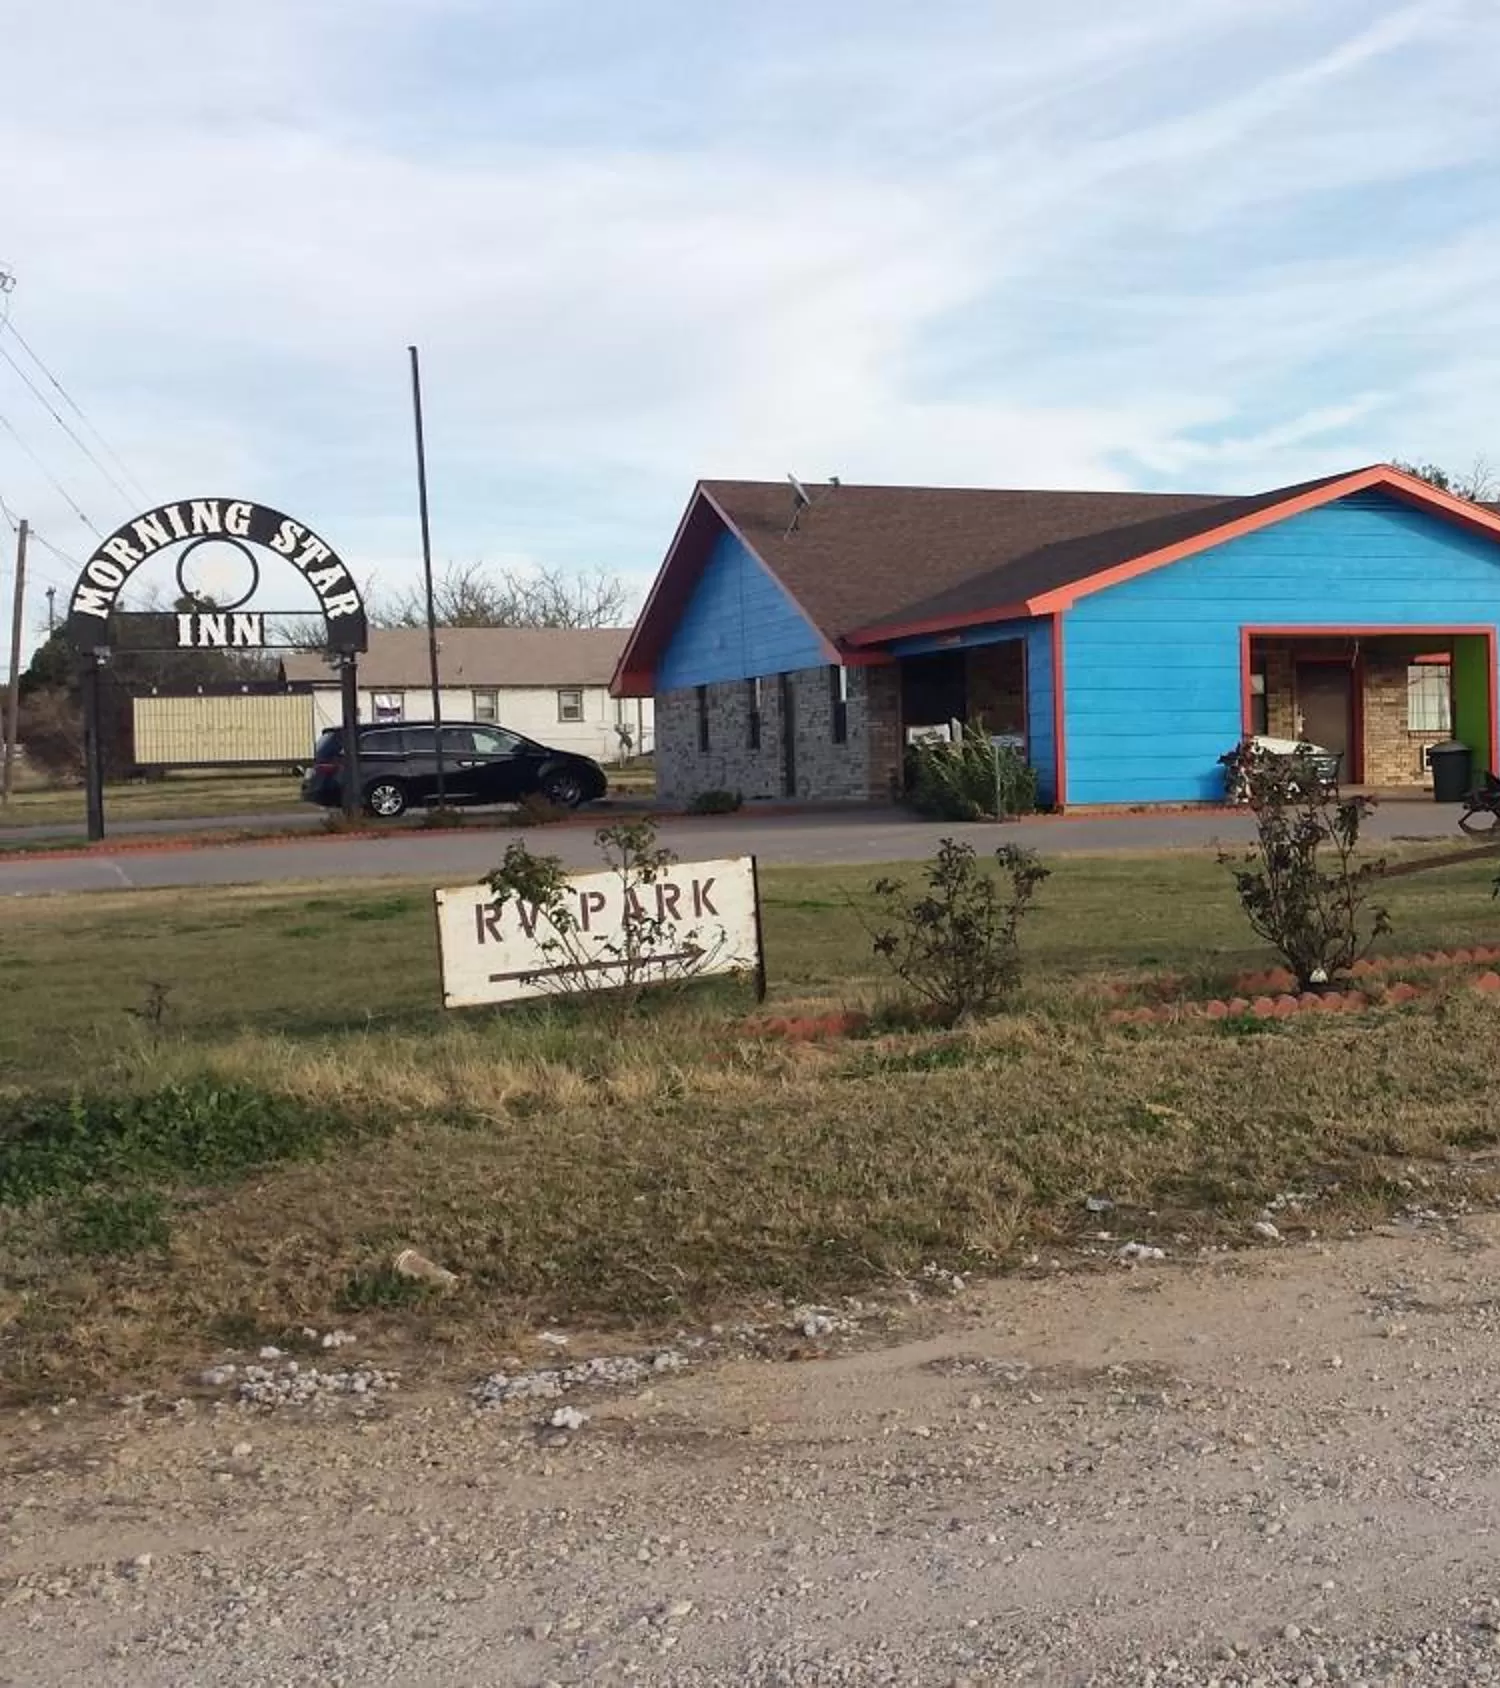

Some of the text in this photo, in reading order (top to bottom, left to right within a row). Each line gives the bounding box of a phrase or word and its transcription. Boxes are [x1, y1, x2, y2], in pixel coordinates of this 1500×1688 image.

[73, 501, 360, 621] MORNING STAR
[176, 612, 264, 647] INN
[475, 877, 719, 944] RV PARK
